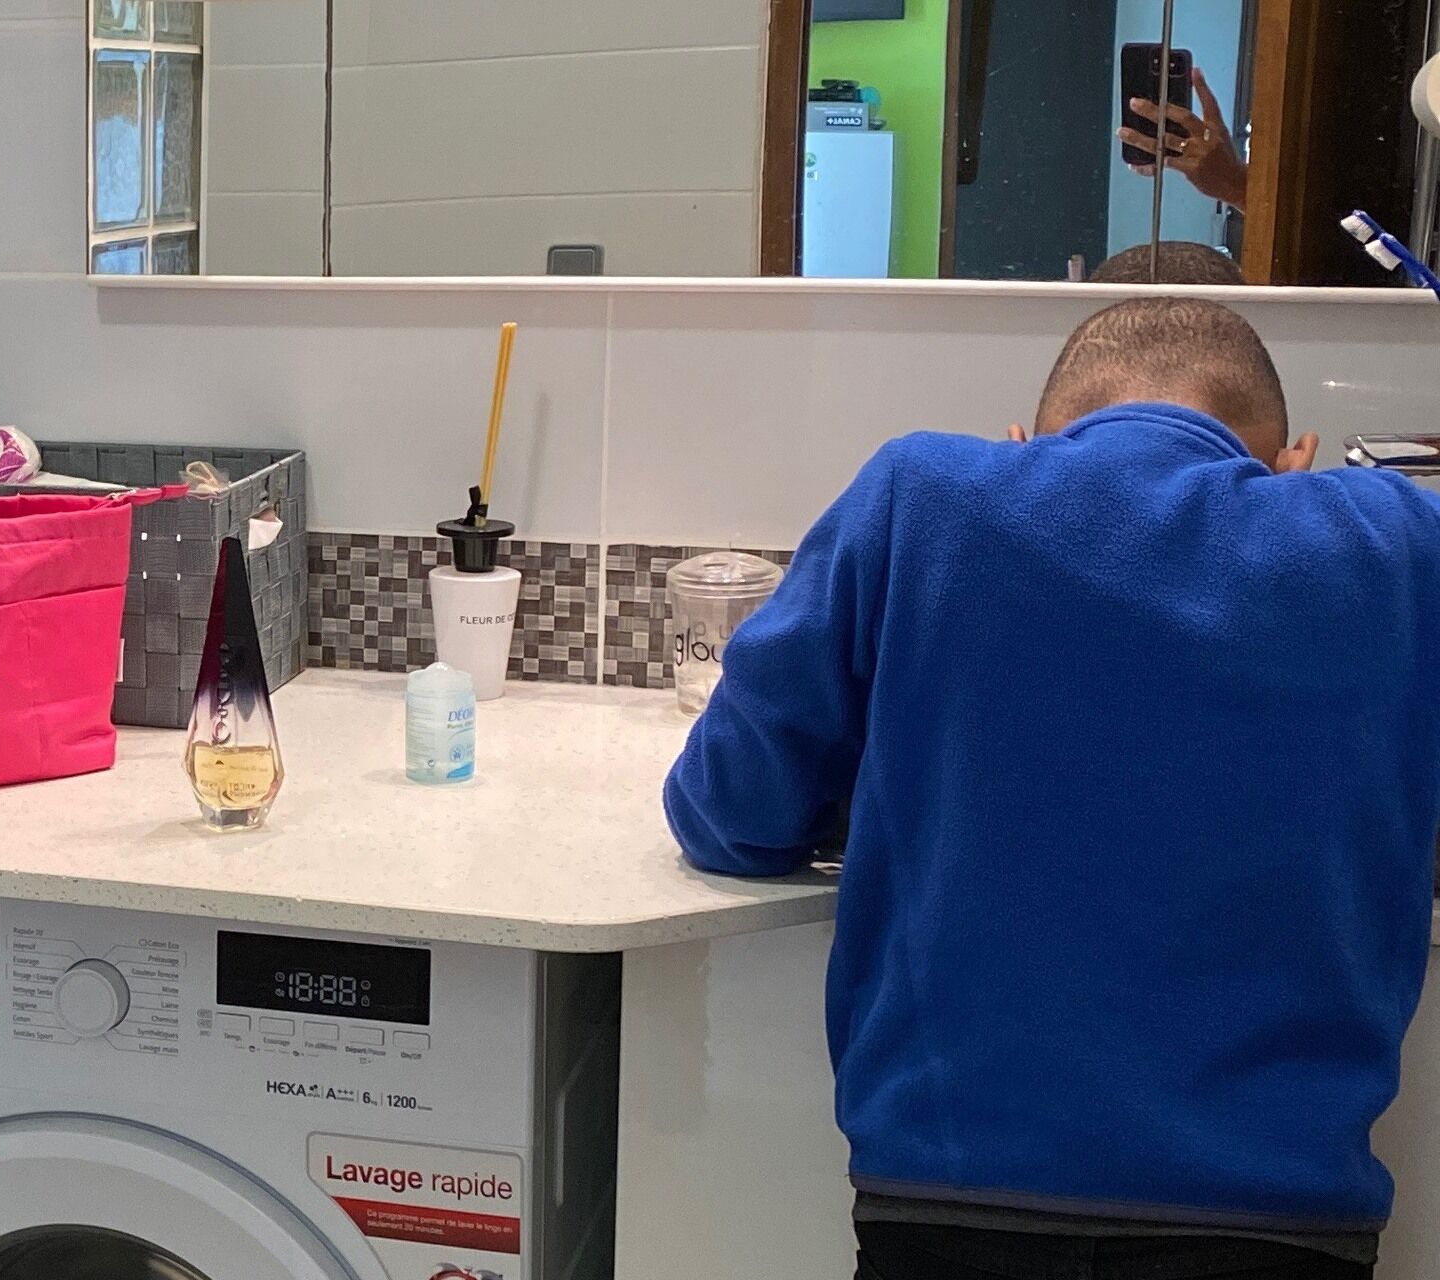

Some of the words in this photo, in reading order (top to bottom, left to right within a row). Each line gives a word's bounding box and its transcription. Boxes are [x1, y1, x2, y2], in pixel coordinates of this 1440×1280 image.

[459, 615, 493, 625] FLEUR
[495, 614, 506, 624] DE
[266, 1080, 307, 1097] HEXA
[387, 1094, 417, 1109] 1200
[325, 1155, 423, 1193] Lavage
[432, 1172, 513, 1200] rapide
